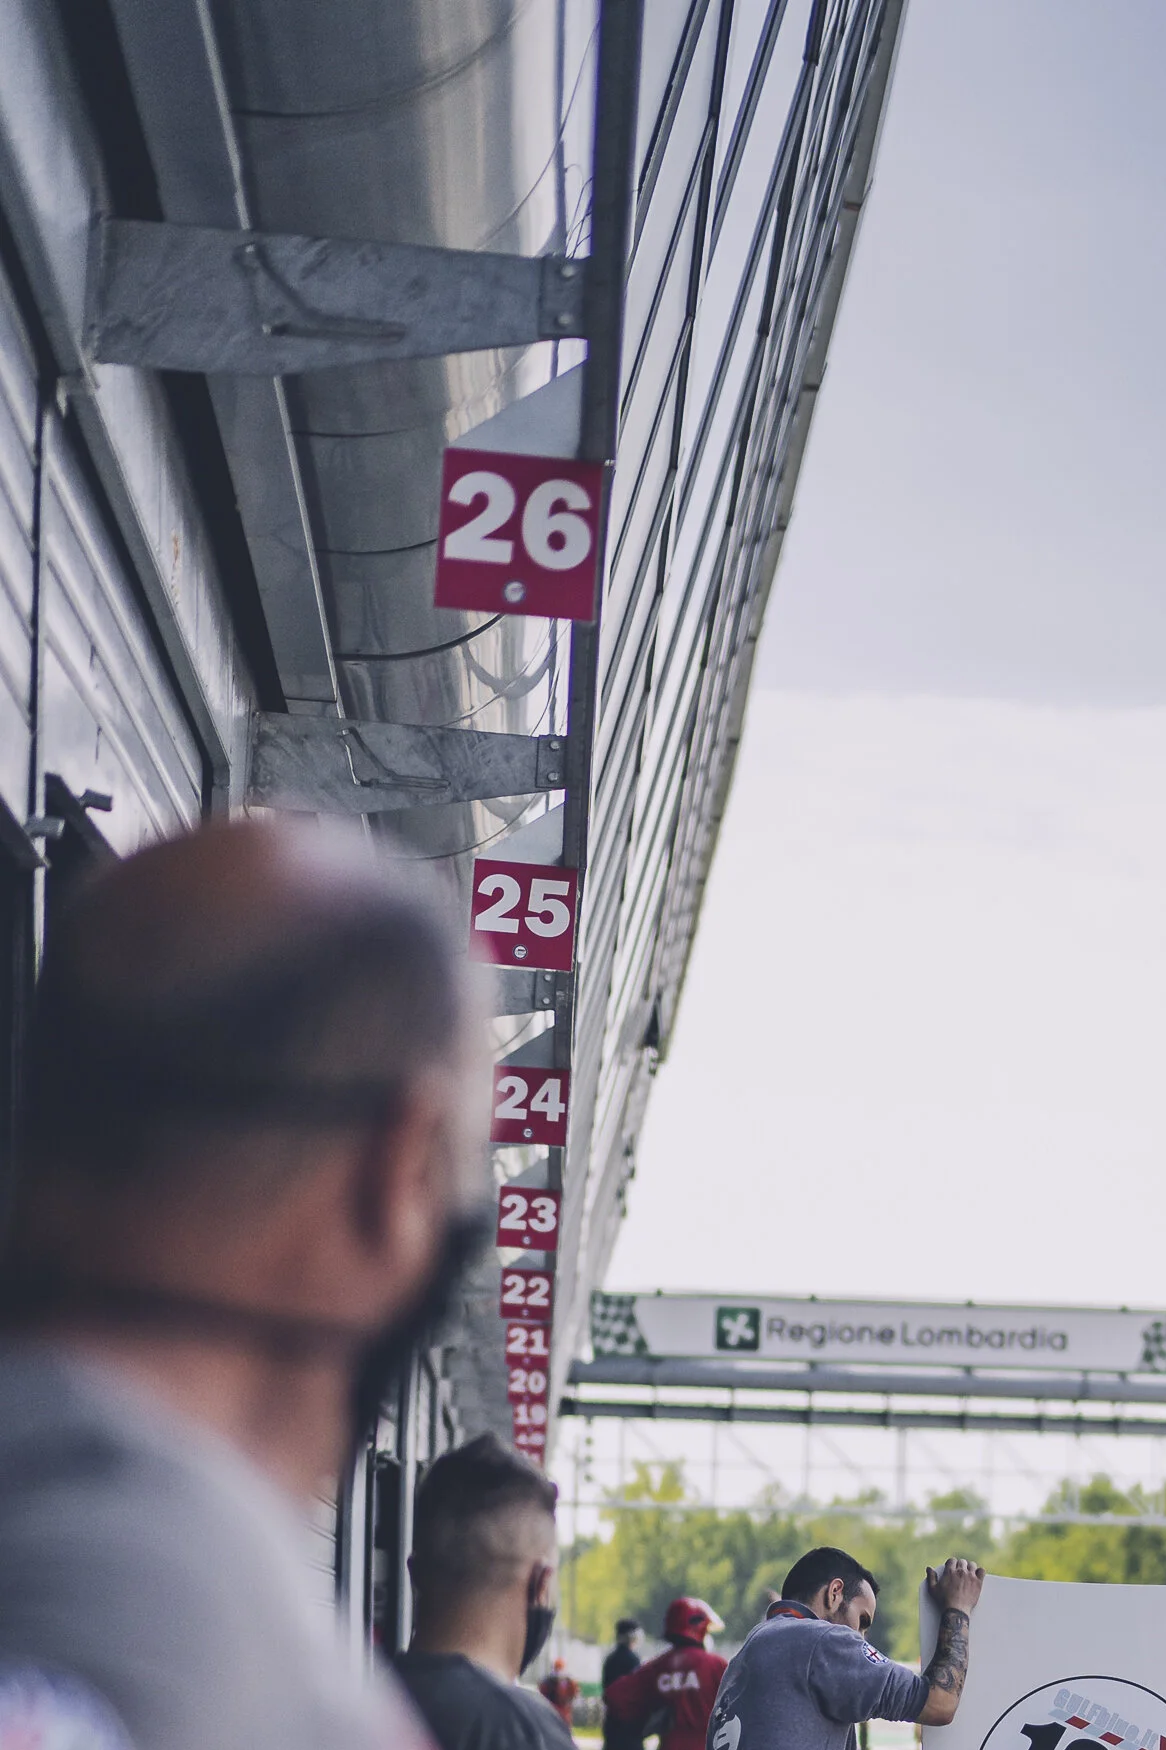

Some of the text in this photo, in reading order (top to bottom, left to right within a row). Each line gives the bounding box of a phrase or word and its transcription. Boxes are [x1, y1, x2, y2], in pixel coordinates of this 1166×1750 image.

[443, 470, 592, 571] 26
[474, 873, 571, 938] 25
[494, 1075, 566, 1122] 24
[500, 1194, 557, 1233] 23
[503, 1274, 550, 1306] 22
[507, 1327, 549, 1356] 21
[509, 1368, 547, 1394] 20
